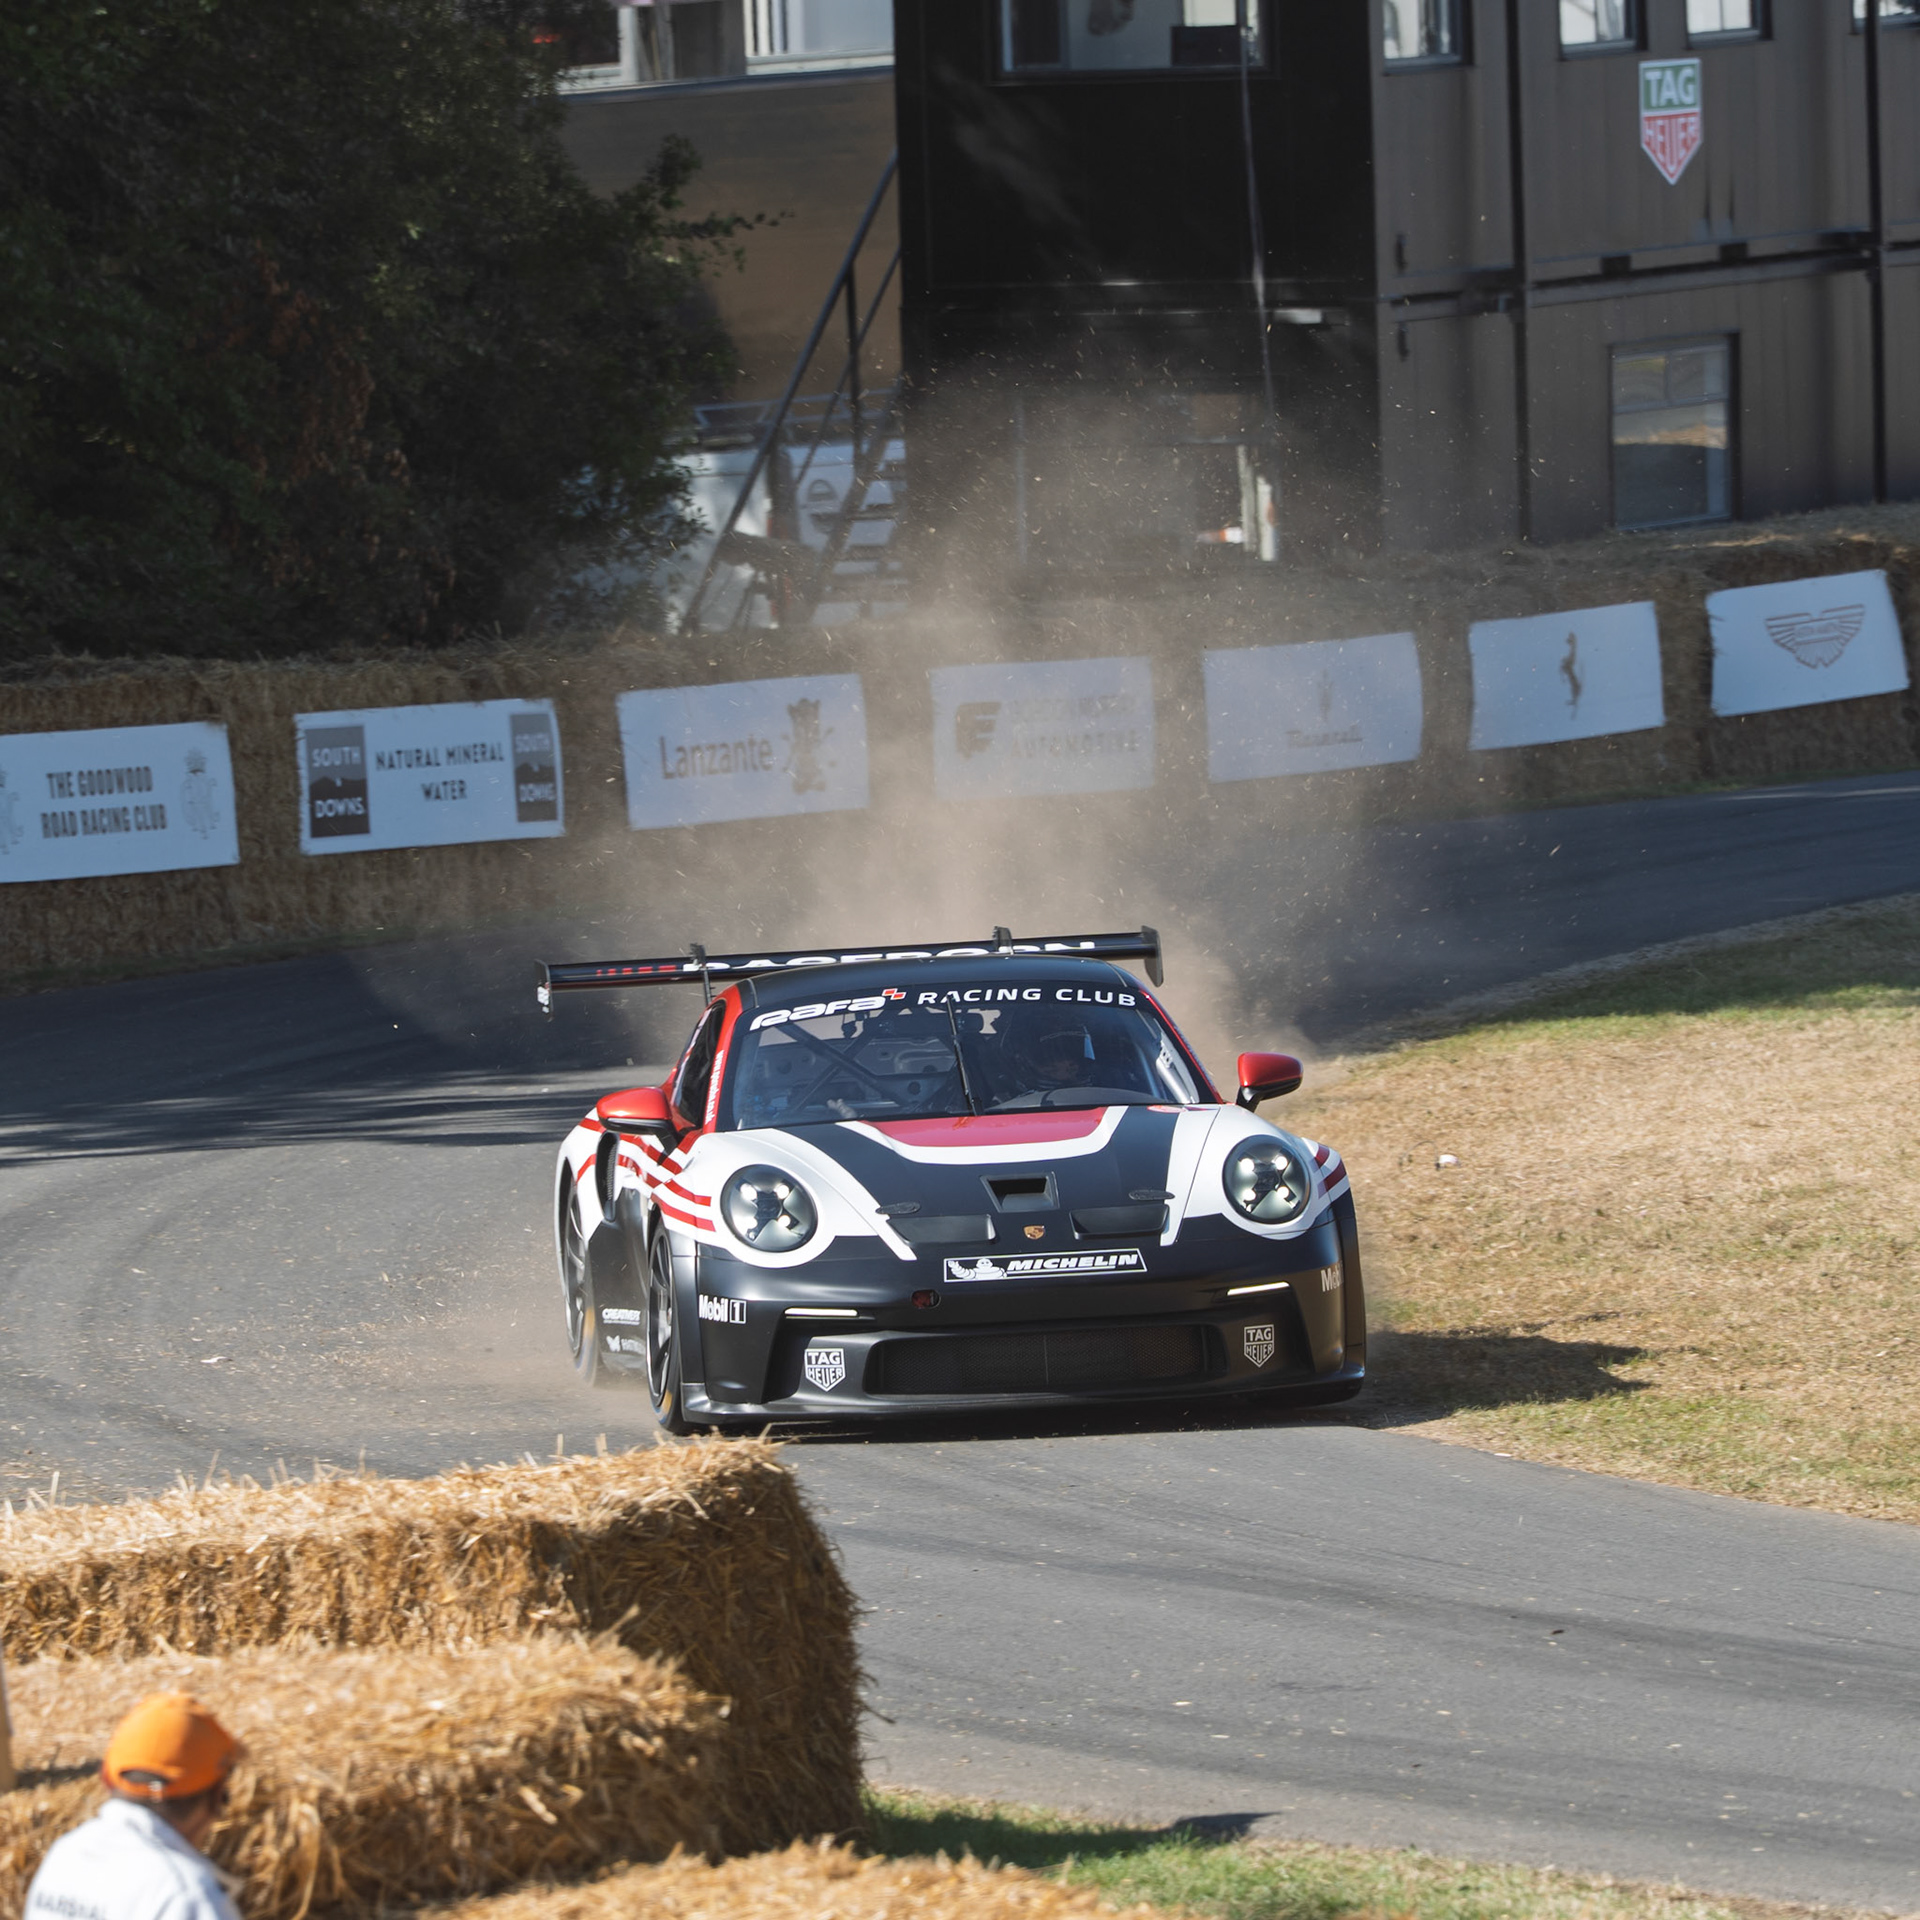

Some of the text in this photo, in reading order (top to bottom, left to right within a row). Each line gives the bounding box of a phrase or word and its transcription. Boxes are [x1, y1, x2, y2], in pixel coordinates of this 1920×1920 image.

[1645, 66, 1696, 108] TAG
[1643, 116, 1699, 172] HEUER
[311, 746, 361, 768] SOUTH
[375, 742, 505, 771] NATURAL MINERAL
[659, 734, 774, 780] Lanzante
[46, 765, 153, 799] THE GOODWOOD
[421, 779, 467, 802] WATER
[315, 797, 366, 819] DOWNS
[41, 803, 167, 839] ROAD RACING CLUB
[917, 988, 1042, 1005] RACING
[1055, 988, 1136, 1006] CLUB
[1007, 1254, 1138, 1271] MICHELIN
[699, 1294, 729, 1323] Mobil
[1247, 1327, 1273, 1342] TAG
[808, 1351, 841, 1366] TAG
[1246, 1343, 1273, 1363] HEUER
[808, 1367, 843, 1388] HEUER
